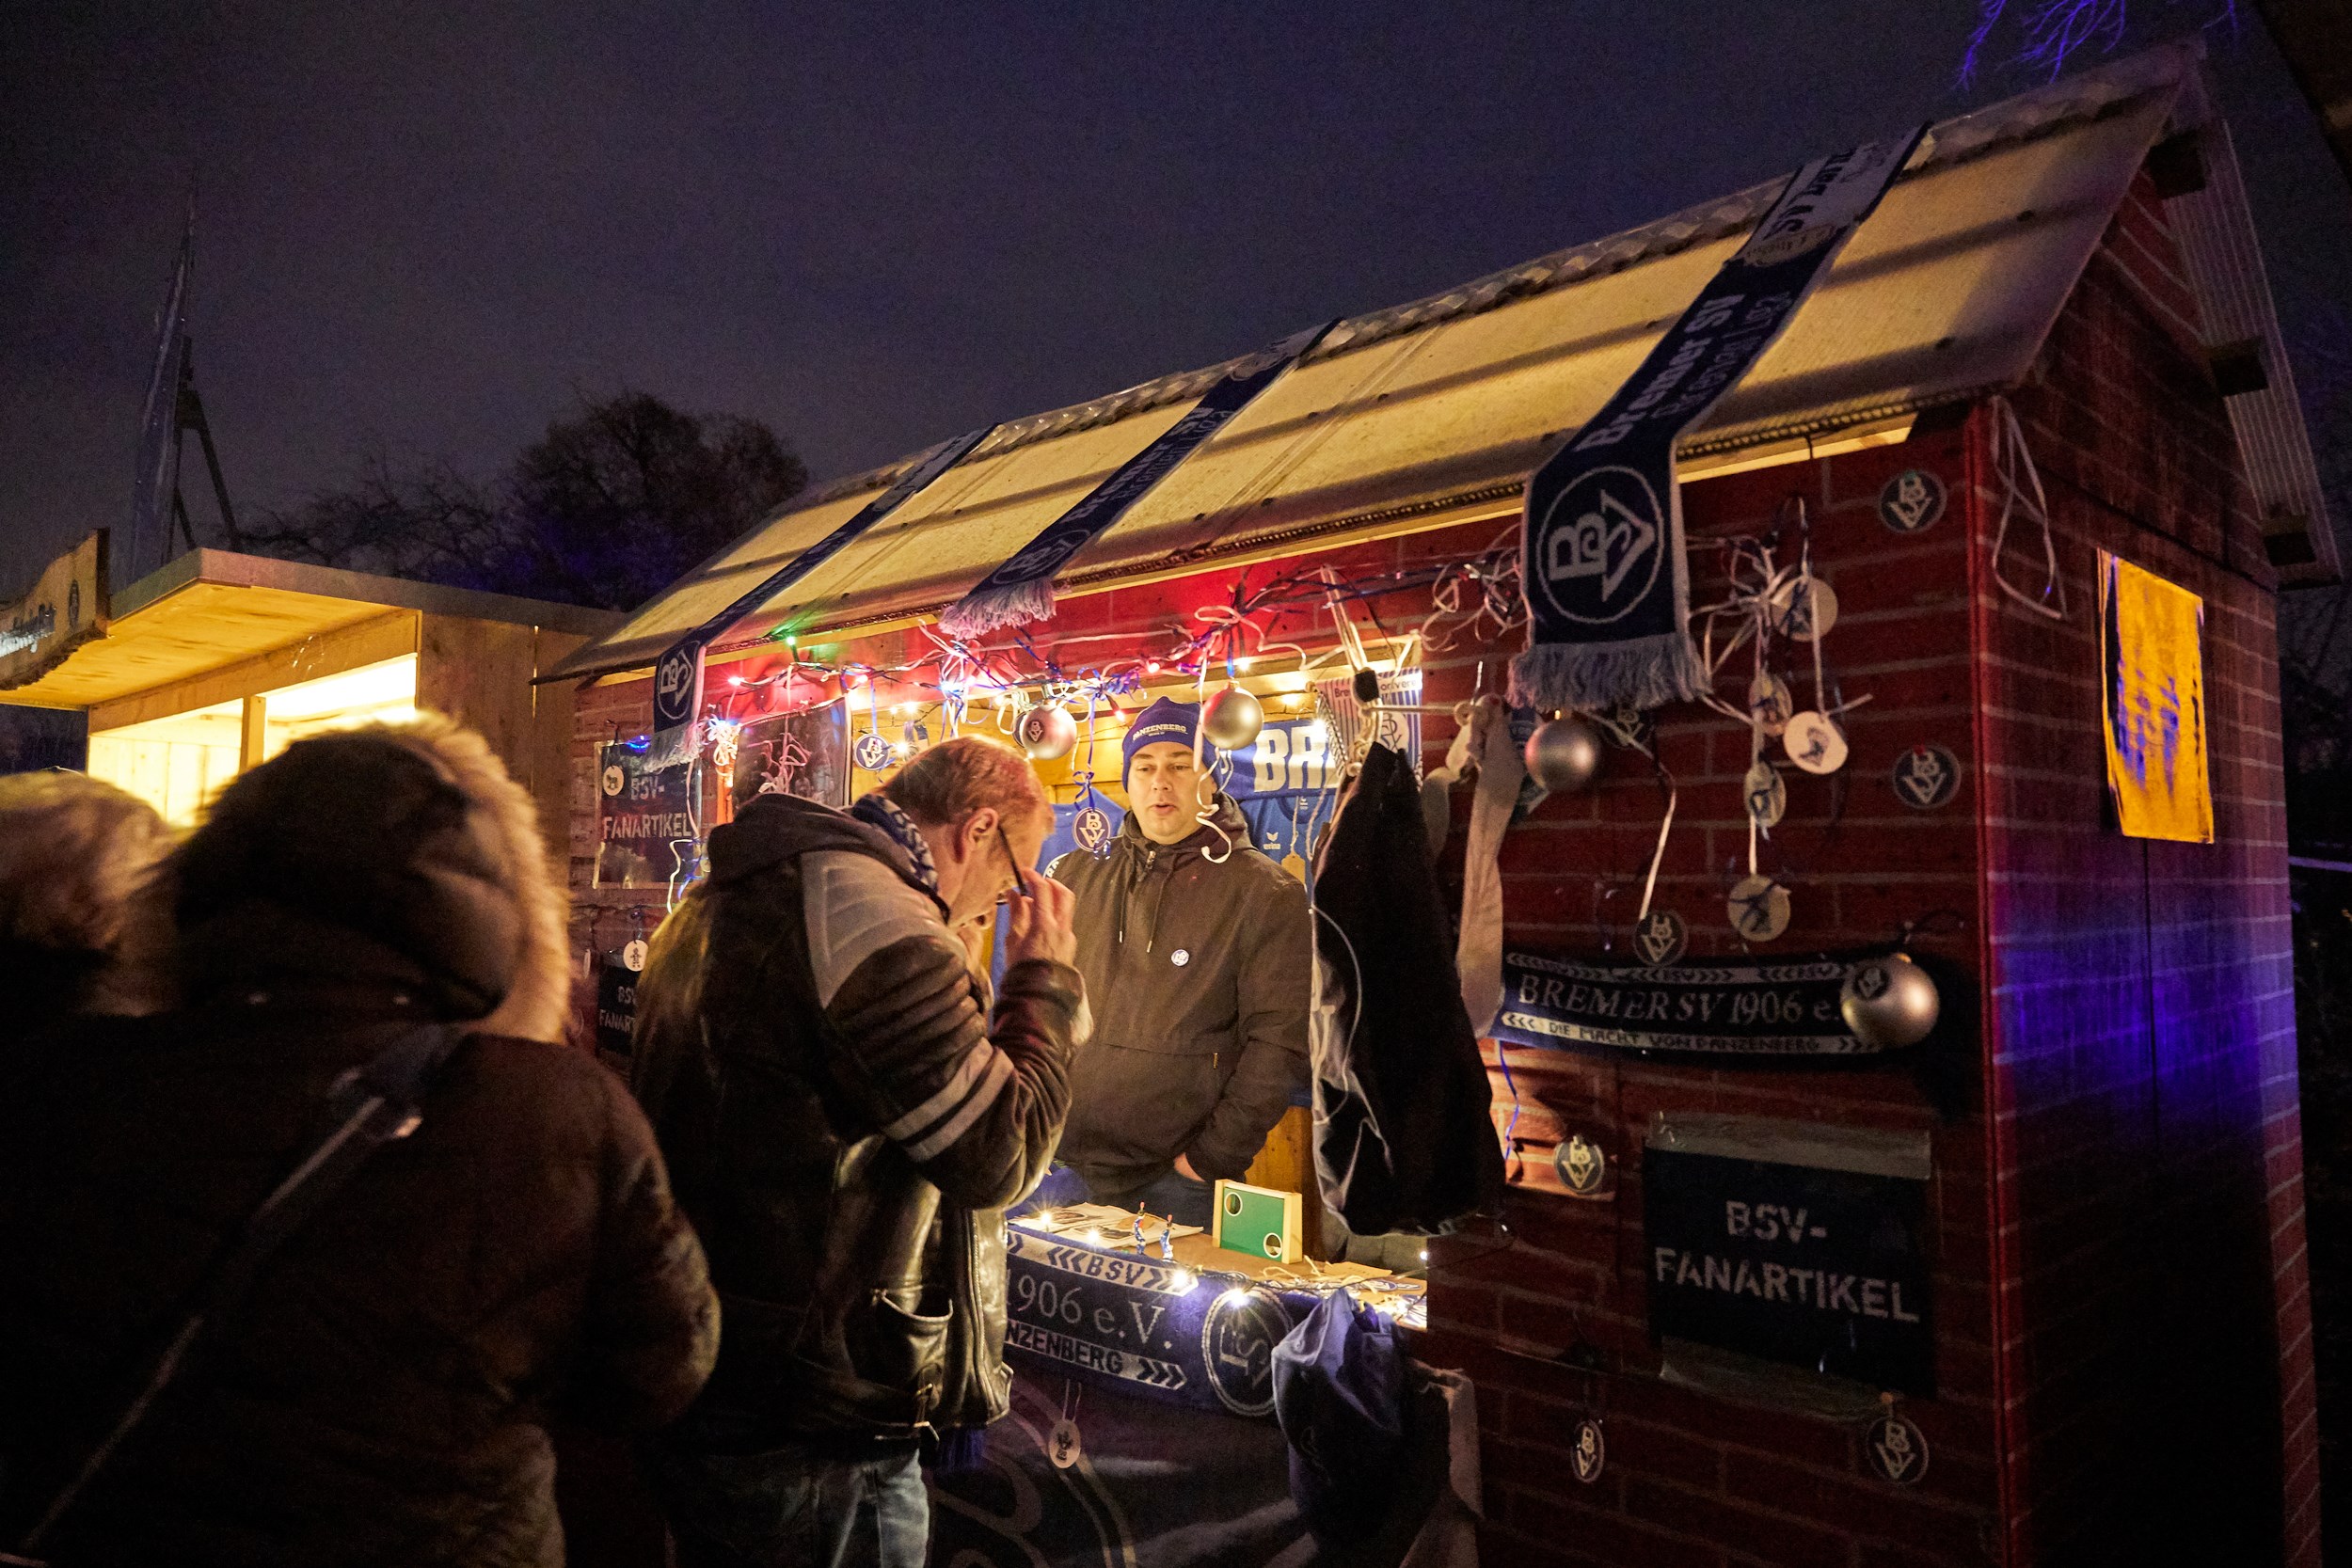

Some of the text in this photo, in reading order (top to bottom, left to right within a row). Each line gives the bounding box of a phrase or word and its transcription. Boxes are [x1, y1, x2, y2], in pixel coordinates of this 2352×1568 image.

[630, 775, 666, 800] BSV-
[603, 812, 692, 840] FANARTIKEL
[617, 985, 637, 1006] BS
[1518, 973, 1670, 1022] BREMER
[1675, 992, 1729, 1023] SV
[1727, 990, 1804, 1025] 1906
[599, 1008, 635, 1034] FANAR
[1549, 1022, 1570, 1036] DIE
[1579, 1026, 1640, 1045] MACHT
[1724, 1199, 1829, 1244] BSV-
[1086, 1256, 1145, 1285] BSV
[1655, 1245, 1920, 1324] FANARTIKEL
[1093, 1301, 1173, 1350] e.V.
[1007, 1319, 1124, 1374] NZENBERG
